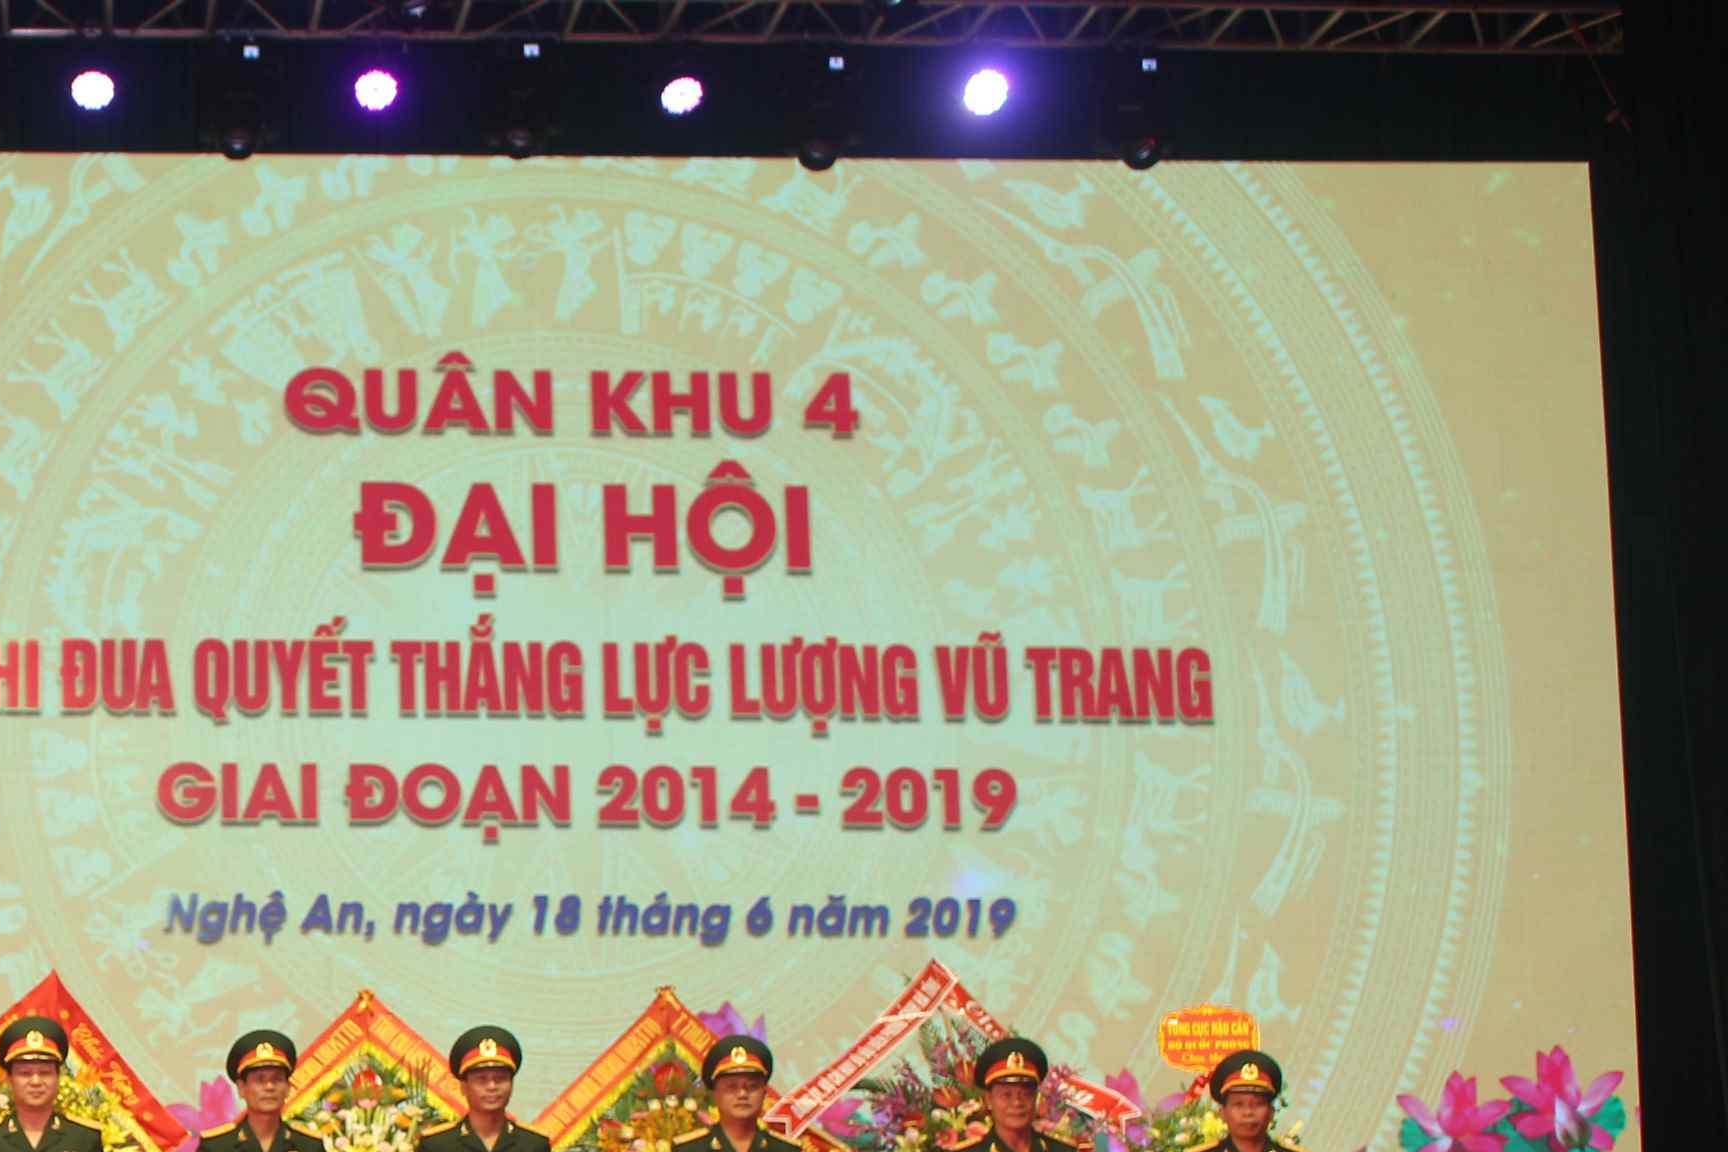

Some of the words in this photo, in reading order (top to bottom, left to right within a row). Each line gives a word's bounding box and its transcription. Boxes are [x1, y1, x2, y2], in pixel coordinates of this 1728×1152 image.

[284, 351, 556, 434] QUÂN
[591, 370, 774, 436] KHU
[804, 373, 861, 435] 4
[353, 482, 559, 595] ĐẠI
[603, 460, 813, 597] HỘI
[60, 638, 176, 712] ĐUA
[194, 616, 376, 722] QUYẾT
[391, 614, 586, 715] THẮNG
[602, 636, 712, 733] LỰC
[730, 638, 921, 734] LƯỢNG
[936, 632, 1011, 719] VŨ
[1025, 647, 1216, 722] TRANG
[157, 762, 320, 823] GIAI
[345, 763, 572, 841] ĐOẠN
[598, 764, 778, 825] 2014
[796, 794, 821, 811] -
[842, 767, 1019, 828] 2019
[166, 890, 288, 946] Nghệ
[300, 893, 376, 942] An,
[393, 890, 514, 946] ngày
[532, 893, 583, 935] 18
[597, 891, 733, 947] tháng
[745, 895, 775, 937] 6
[787, 894, 891, 938] năm
[905, 896, 1017, 938] 2019
